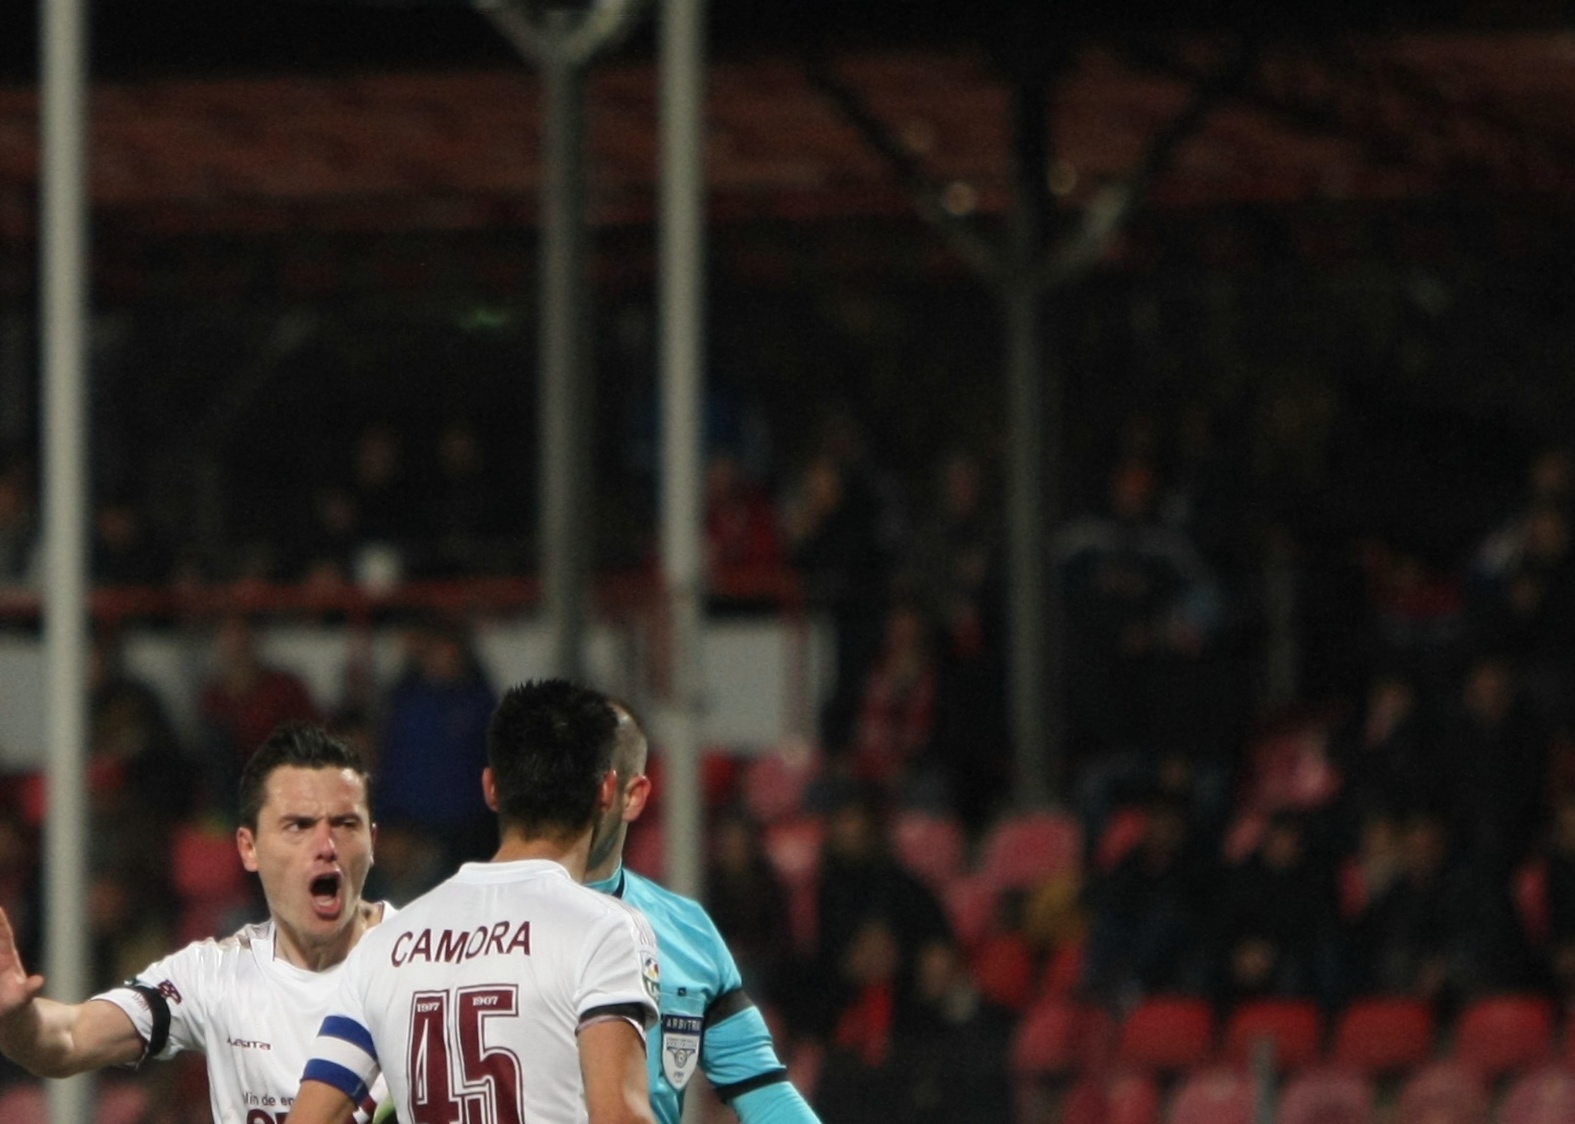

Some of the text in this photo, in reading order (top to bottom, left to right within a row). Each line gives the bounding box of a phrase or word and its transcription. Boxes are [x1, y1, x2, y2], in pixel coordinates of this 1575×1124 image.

[391, 921, 531, 967] CAMORA
[472, 995, 499, 1006] 1907
[261, 1093, 276, 1107] de
[280, 1096, 295, 1107] en
